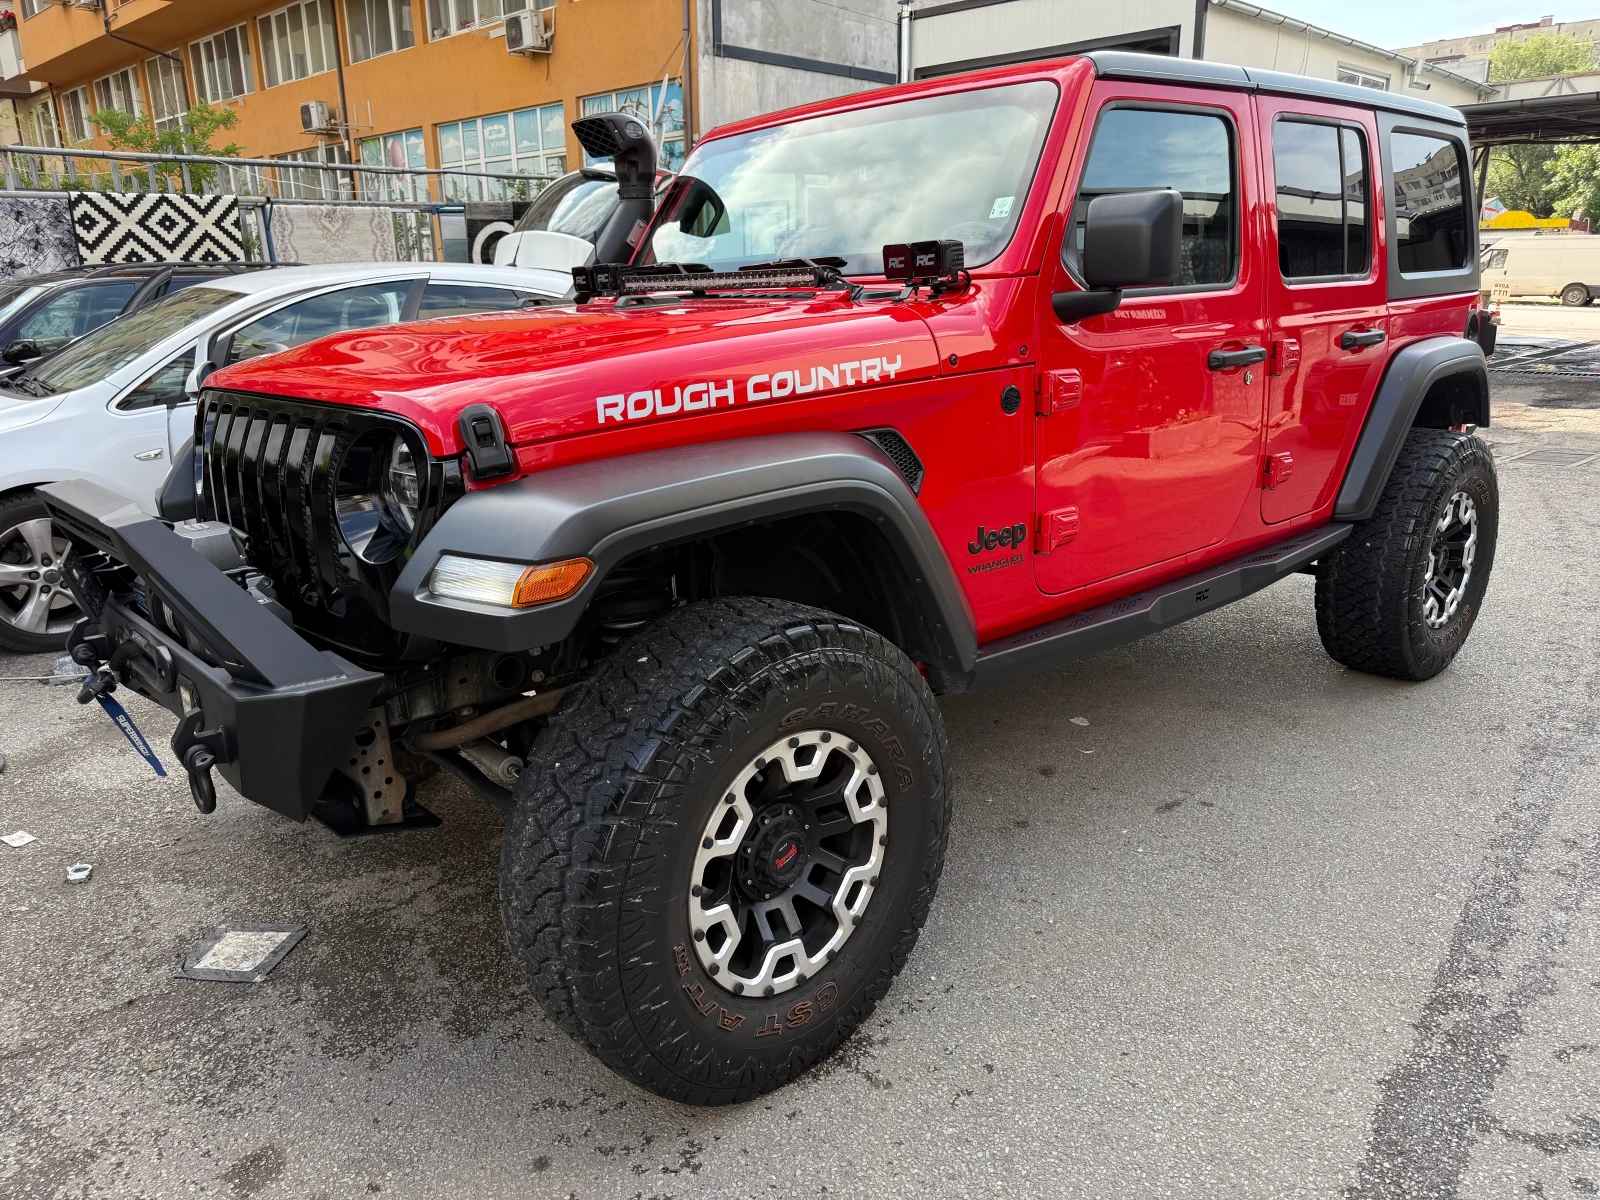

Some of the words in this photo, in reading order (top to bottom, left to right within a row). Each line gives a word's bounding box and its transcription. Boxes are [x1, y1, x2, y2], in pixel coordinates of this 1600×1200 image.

[888, 257, 905, 269] RC
[916, 254, 936, 267] RC
[575, 276, 587, 285] RC
[597, 273, 609, 283] RC
[596, 378, 735, 424] ROUGH
[747, 354, 902, 403] COUNTRY
[968, 522, 1027, 555] Jeep
[967, 553, 1024, 574] WRANGLER
[1195, 588, 1210, 603] RC
[115, 714, 151, 757] SUPERWINCH
[777, 701, 915, 794] SAHARA
[754, 981, 839, 1038] CST
